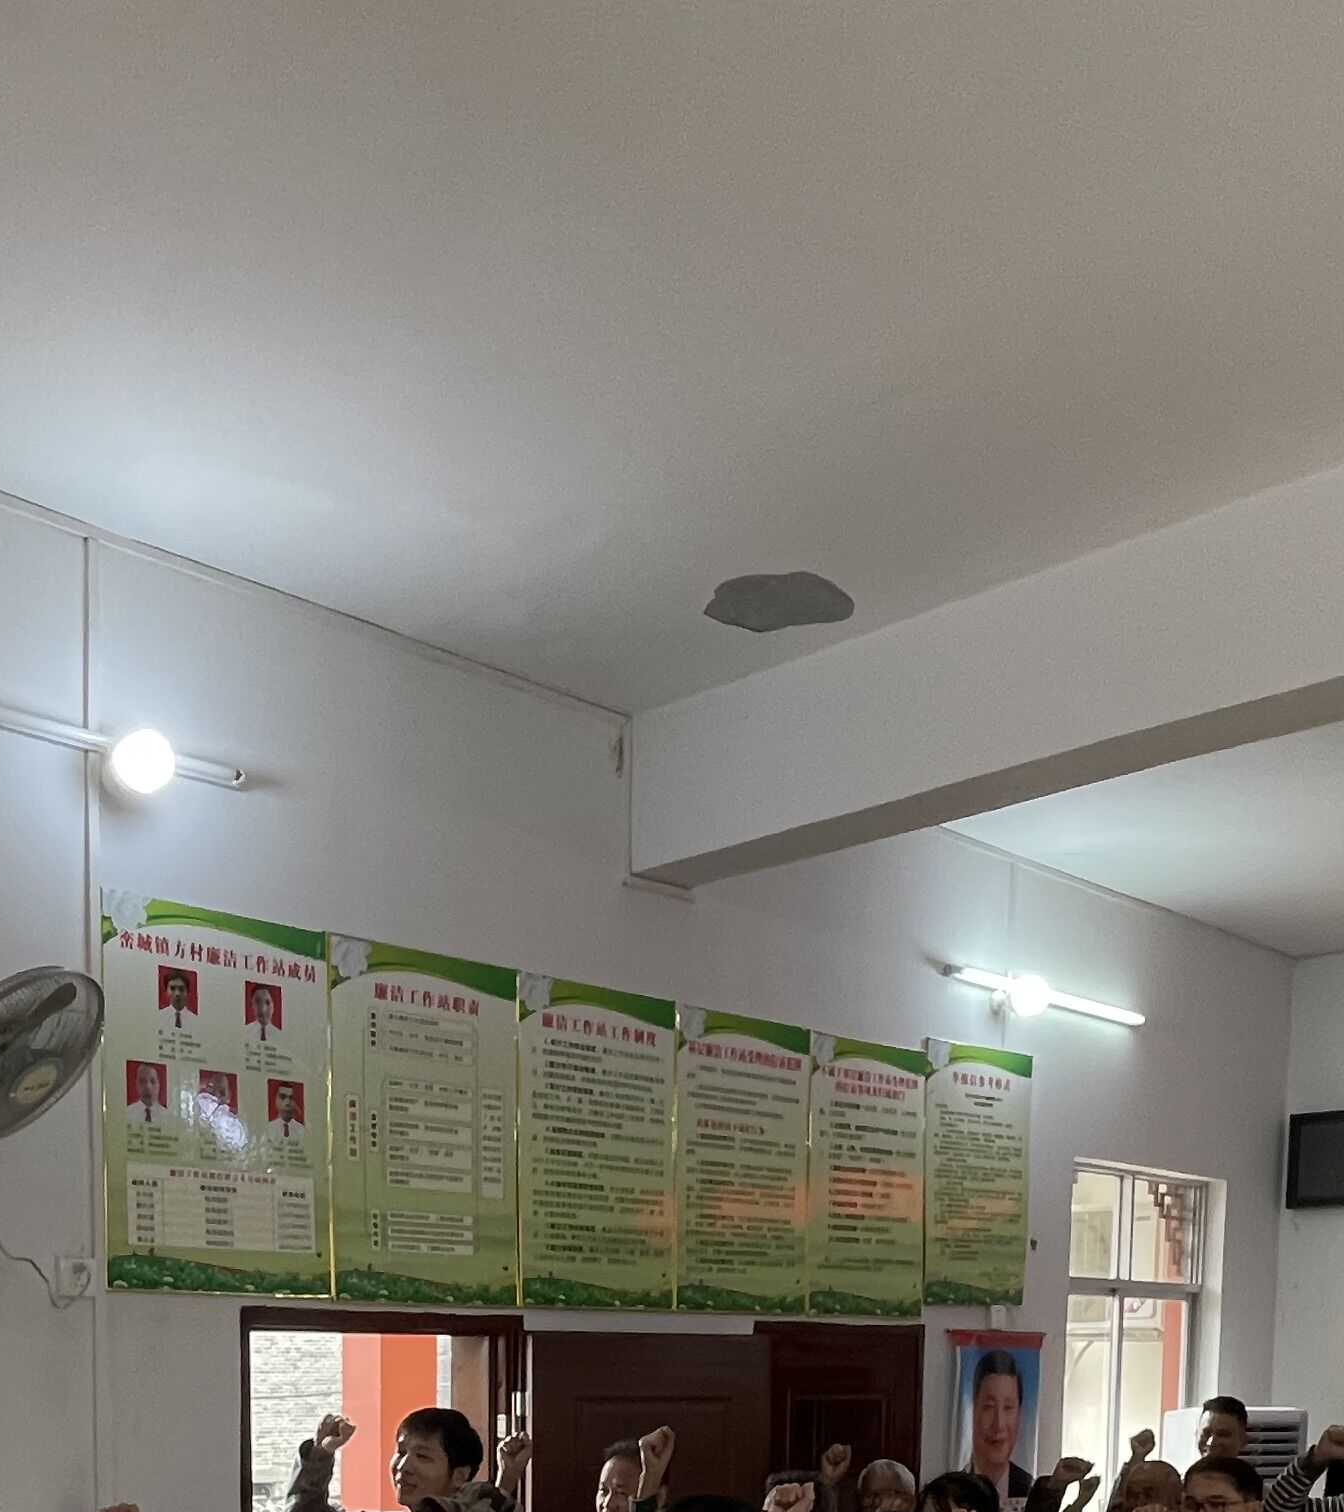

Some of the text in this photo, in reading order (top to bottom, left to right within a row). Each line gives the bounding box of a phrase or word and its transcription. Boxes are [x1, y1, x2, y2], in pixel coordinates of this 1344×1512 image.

[374, 982, 479, 1016] 廉洁工作站职责
